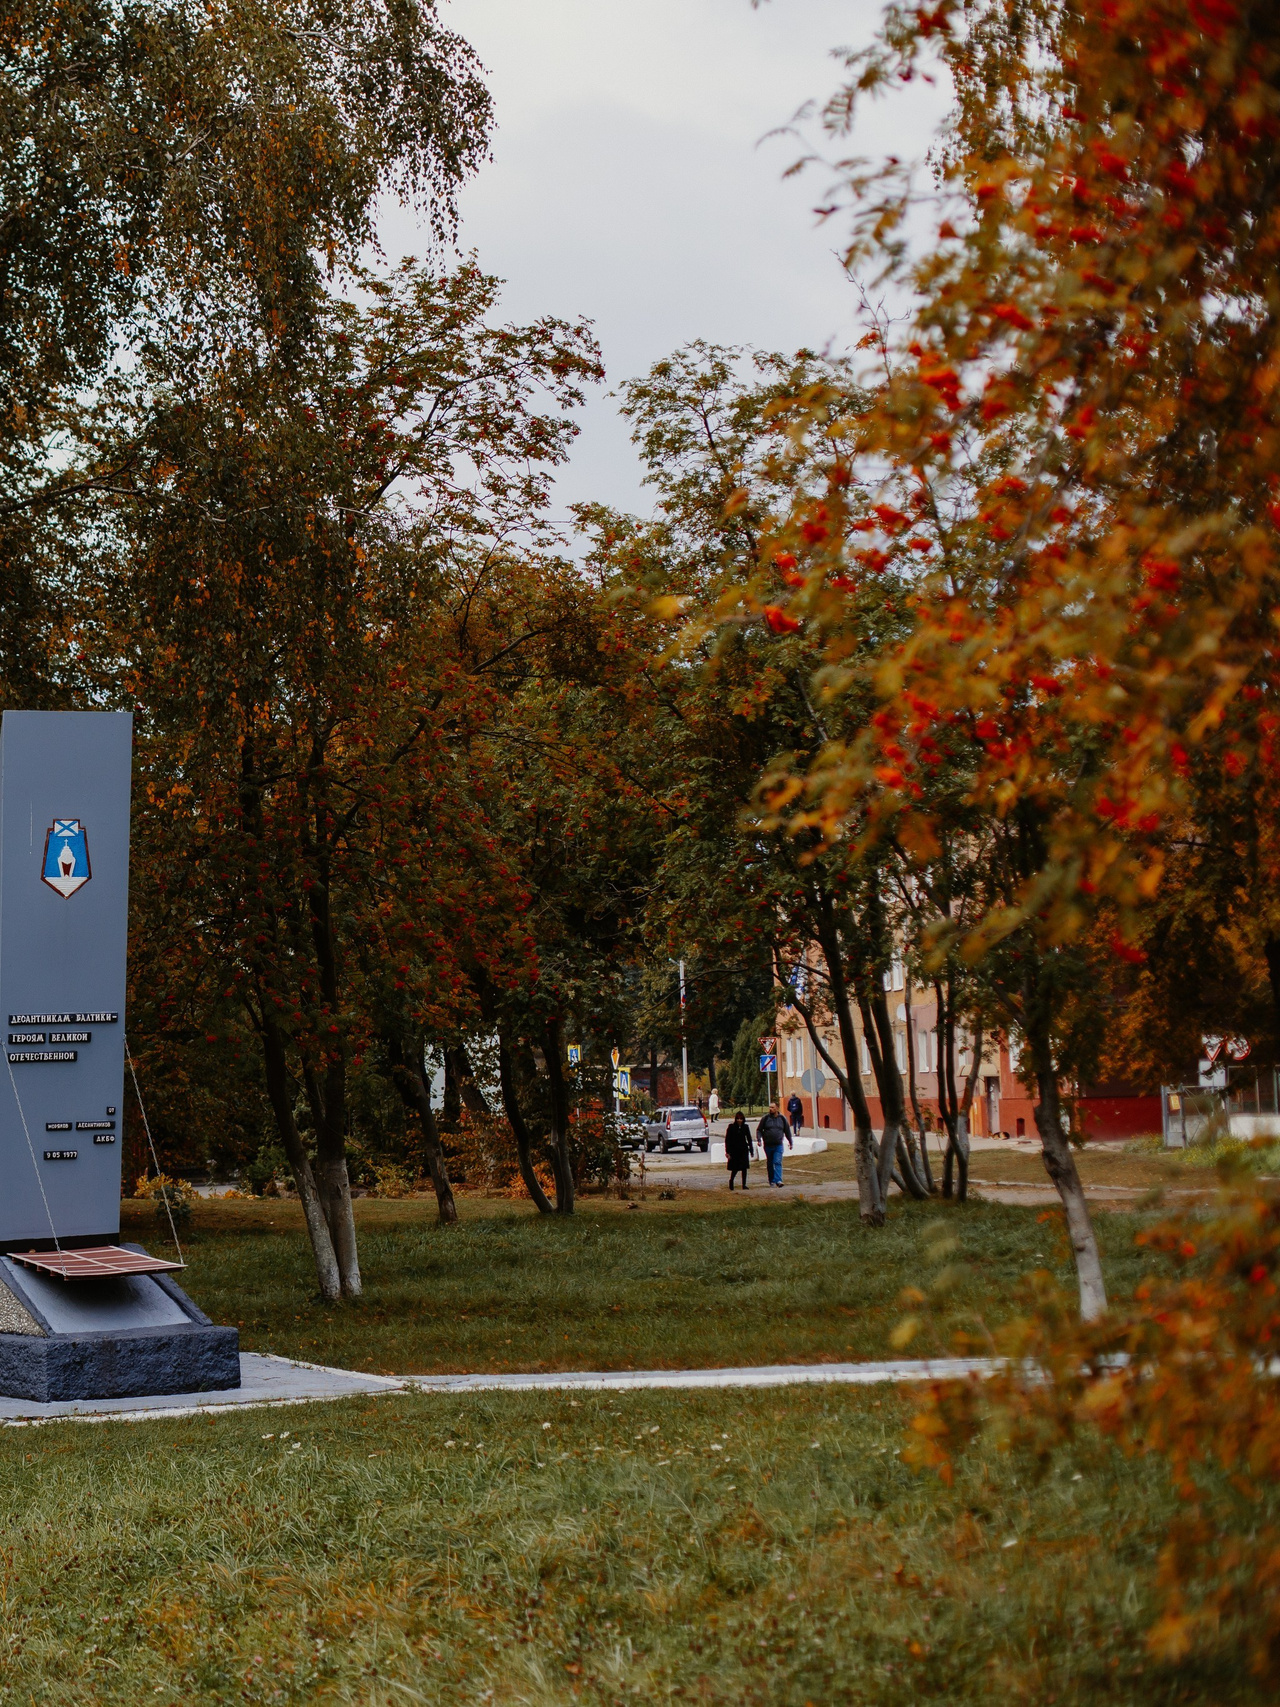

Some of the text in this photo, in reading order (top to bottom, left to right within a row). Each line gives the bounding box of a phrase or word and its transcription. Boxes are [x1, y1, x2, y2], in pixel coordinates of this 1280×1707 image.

[10, 1013, 118, 1024] ДЕСАНТНИКАМ БАЛТИКИ-
[12, 1034, 45, 1043] ГЕРОЯМ
